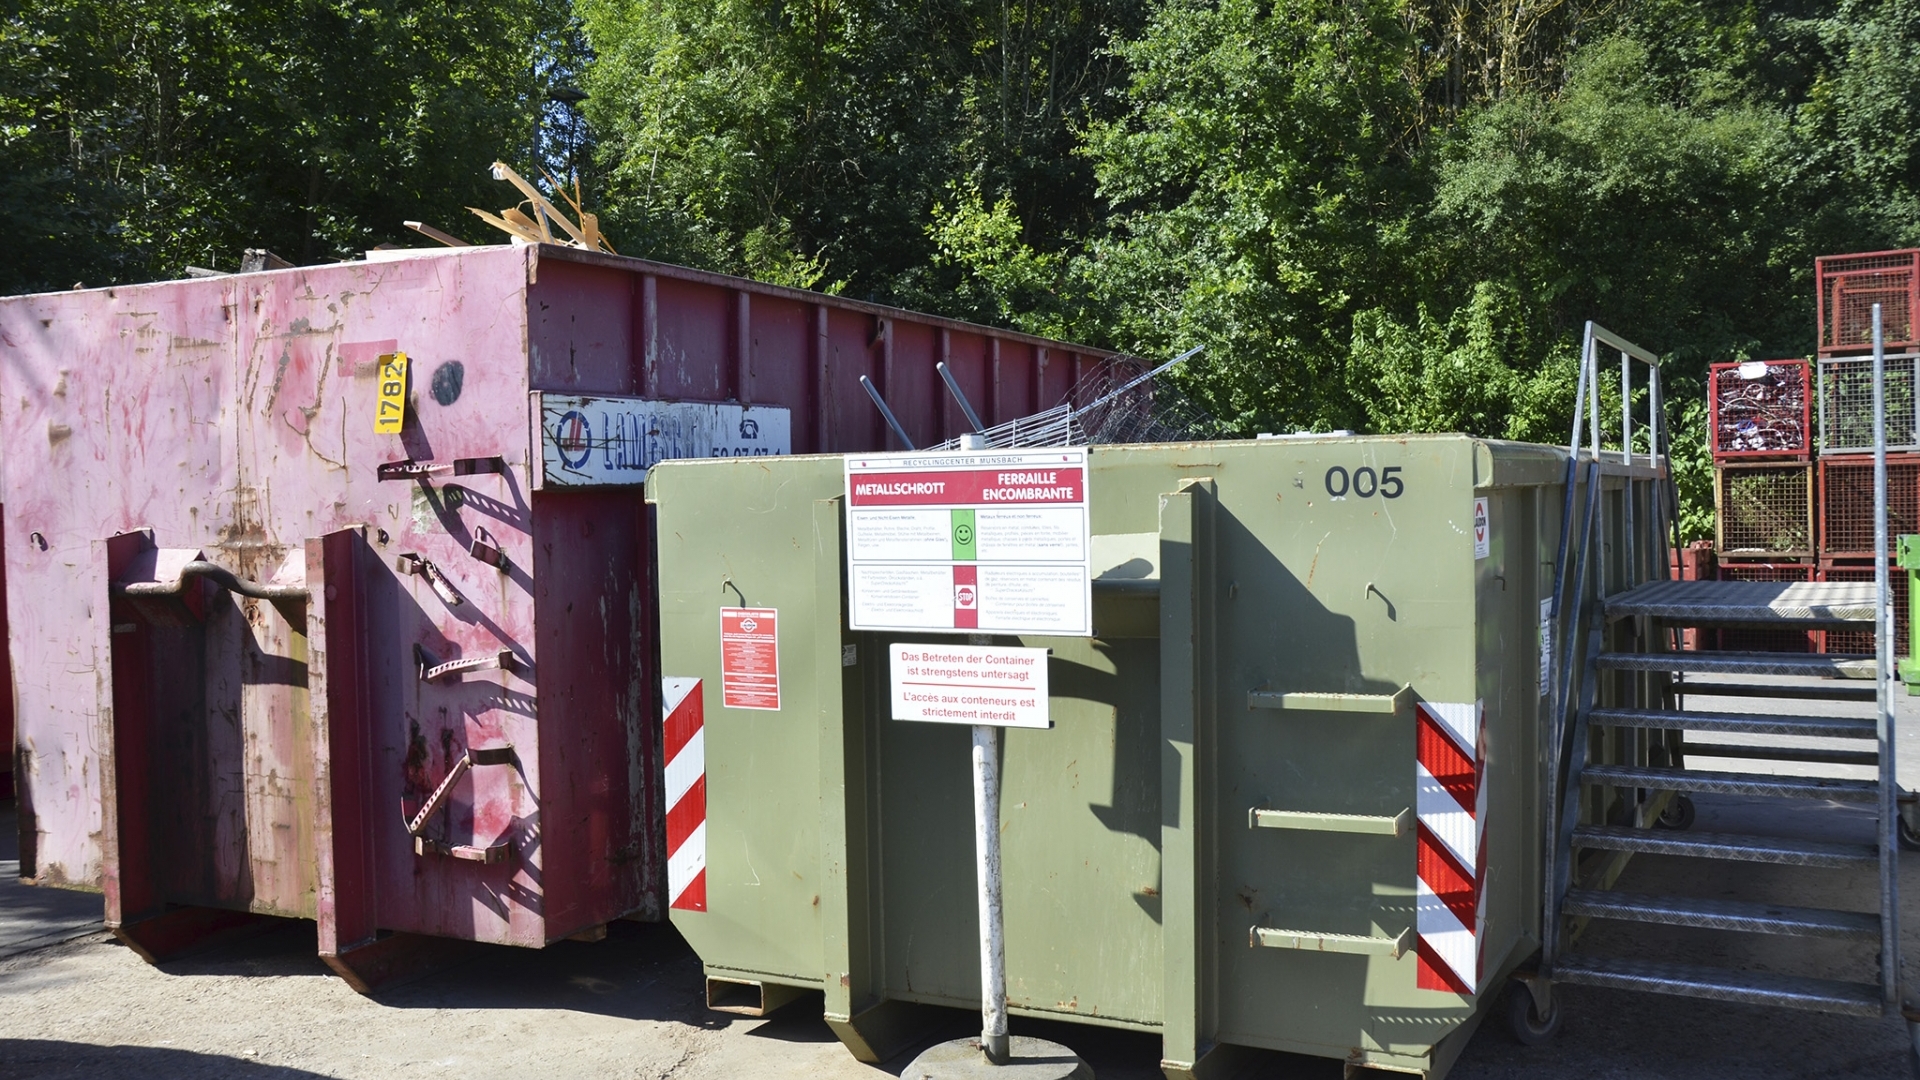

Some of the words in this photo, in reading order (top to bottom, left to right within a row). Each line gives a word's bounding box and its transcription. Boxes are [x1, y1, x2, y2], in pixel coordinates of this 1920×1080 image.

[379, 362, 404, 425] 1782
[903, 457, 976, 467] RECYCLINGCENTER
[980, 456, 1023, 464] MUNSBACH
[997, 472, 1057, 485] FERRAILLE
[1324, 465, 1405, 499] 005
[855, 482, 945, 496] METALLSCHROTT
[982, 487, 1074, 500] ENCOMBRANTE
[901, 651, 920, 662] Das
[922, 652, 964, 663] Betreten
[966, 654, 983, 664] der
[985, 654, 1035, 665] Container
[907, 665, 919, 676] ist
[921, 667, 979, 679] strengstens
[981, 670, 1029, 682] untersagt
[903, 691, 939, 703] L'accès
[941, 695, 959, 704] aux
[961, 696, 1017, 706] conteneurs
[1019, 698, 1035, 708] est
[922, 707, 977, 718] strictement
[980, 709, 1016, 721] interdit
